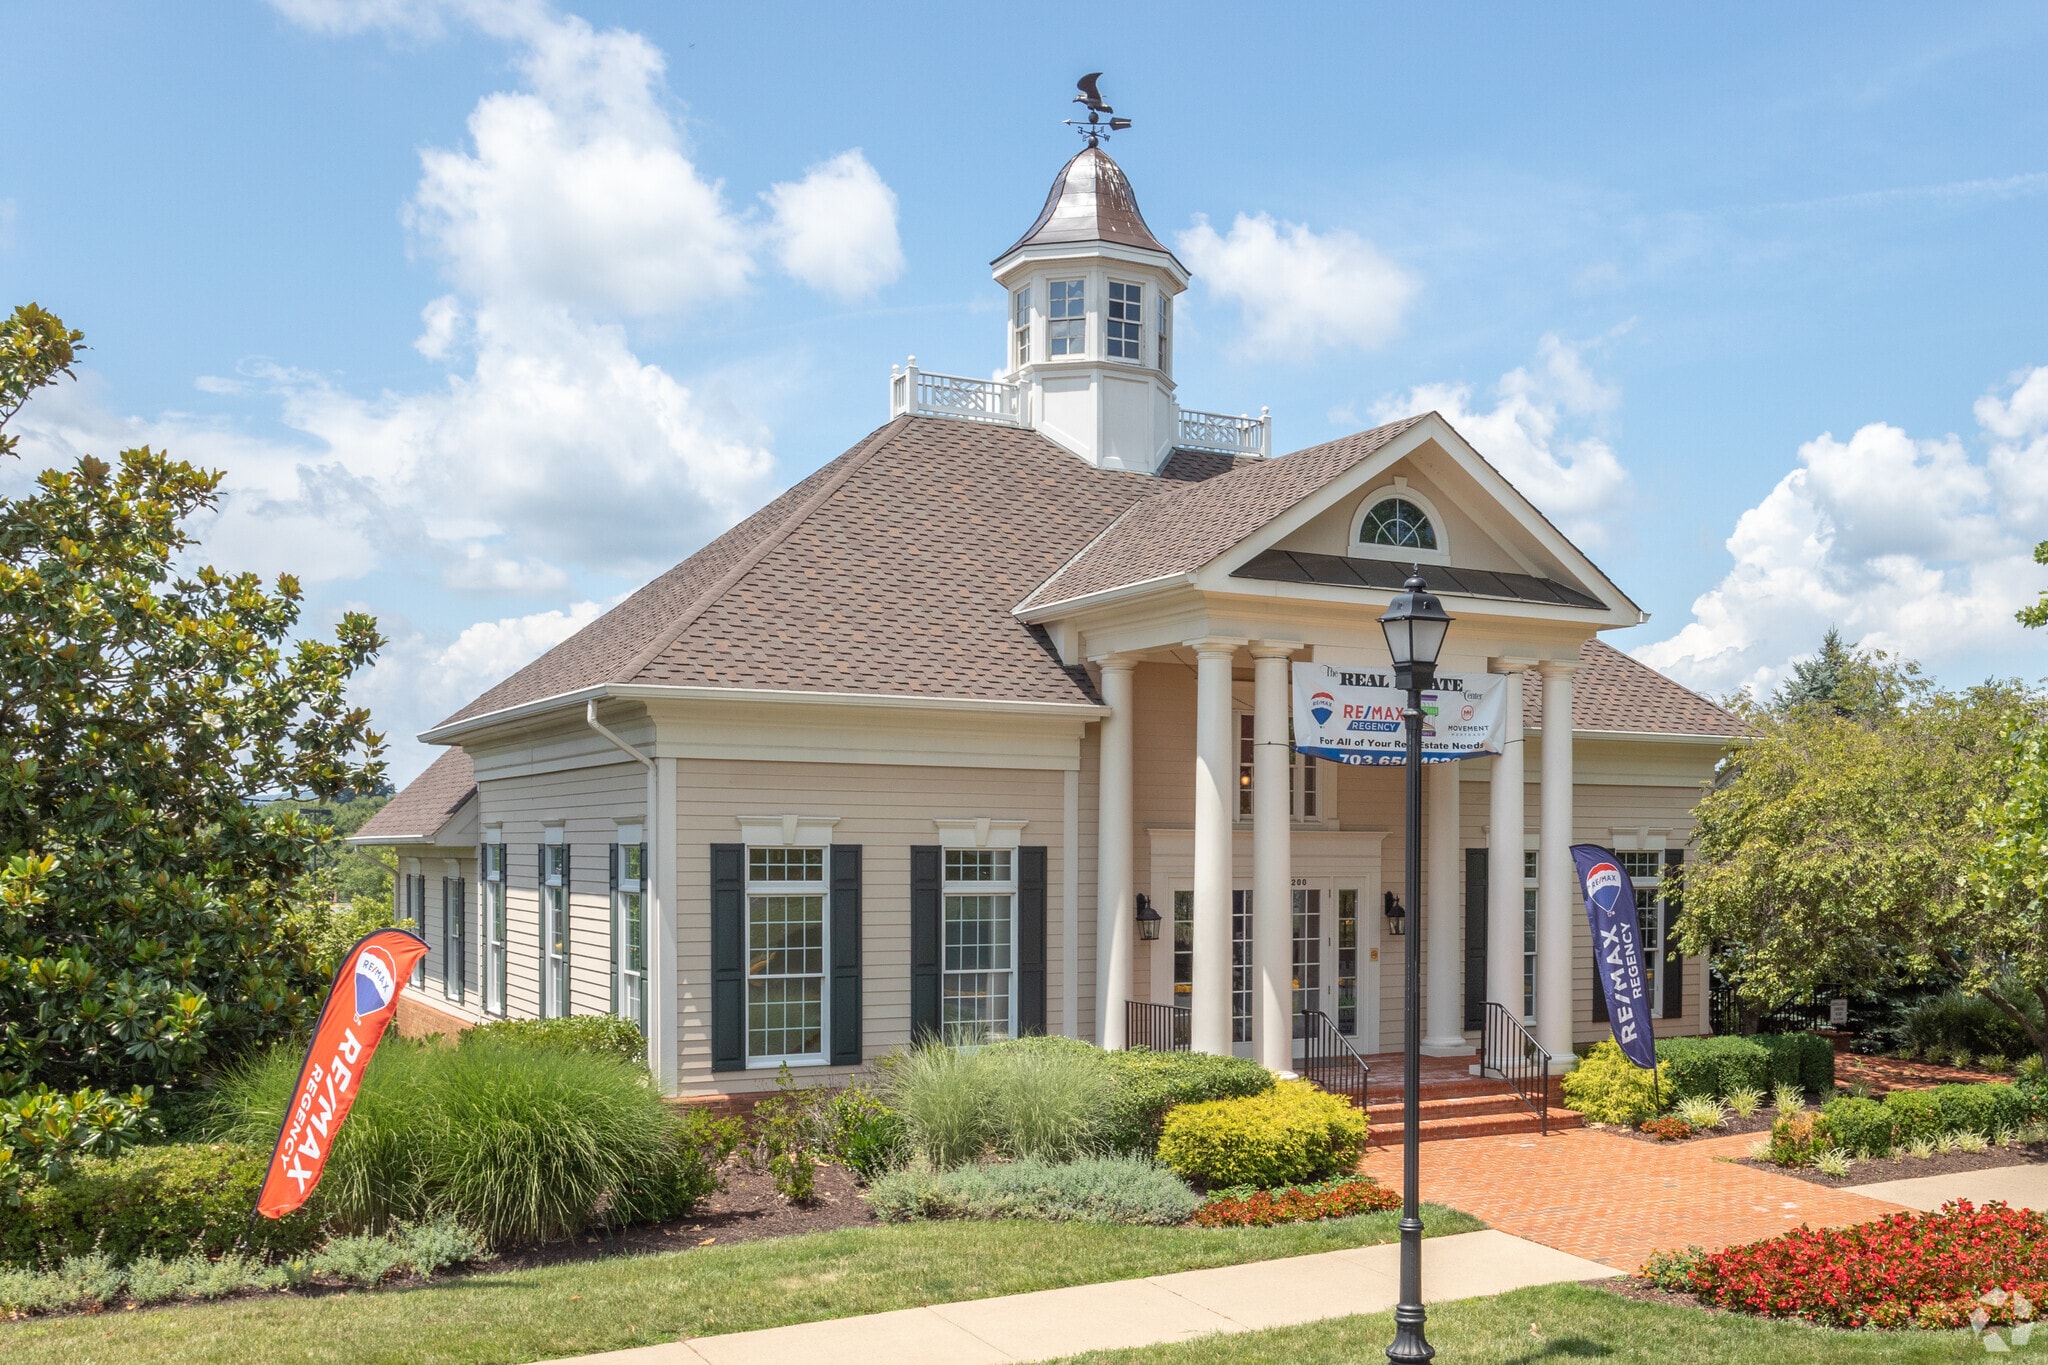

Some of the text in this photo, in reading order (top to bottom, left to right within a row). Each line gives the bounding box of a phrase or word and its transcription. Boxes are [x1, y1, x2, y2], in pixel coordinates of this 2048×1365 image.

[1320, 664, 1338, 677] The
[1339, 672, 1390, 688] REAL
[1462, 689, 1483, 702] Center
[1343, 704, 1405, 721] RE/MAX
[1352, 722, 1396, 731] REGENCY
[1319, 736, 1334, 745] For
[1337, 738, 1351, 746] All
[1354, 738, 1364, 746] of
[1368, 739, 1391, 748] Your
[1291, 878, 1307, 886] 200
[1591, 874, 1617, 891] RE/MAX
[1620, 922, 1643, 1000] REGENCY
[362, 959, 390, 993] RE/MAX
[1600, 924, 1638, 1045] RE/MAX
[280, 1063, 324, 1171] REGENCY
[286, 1028, 363, 1194] RE/MAX
